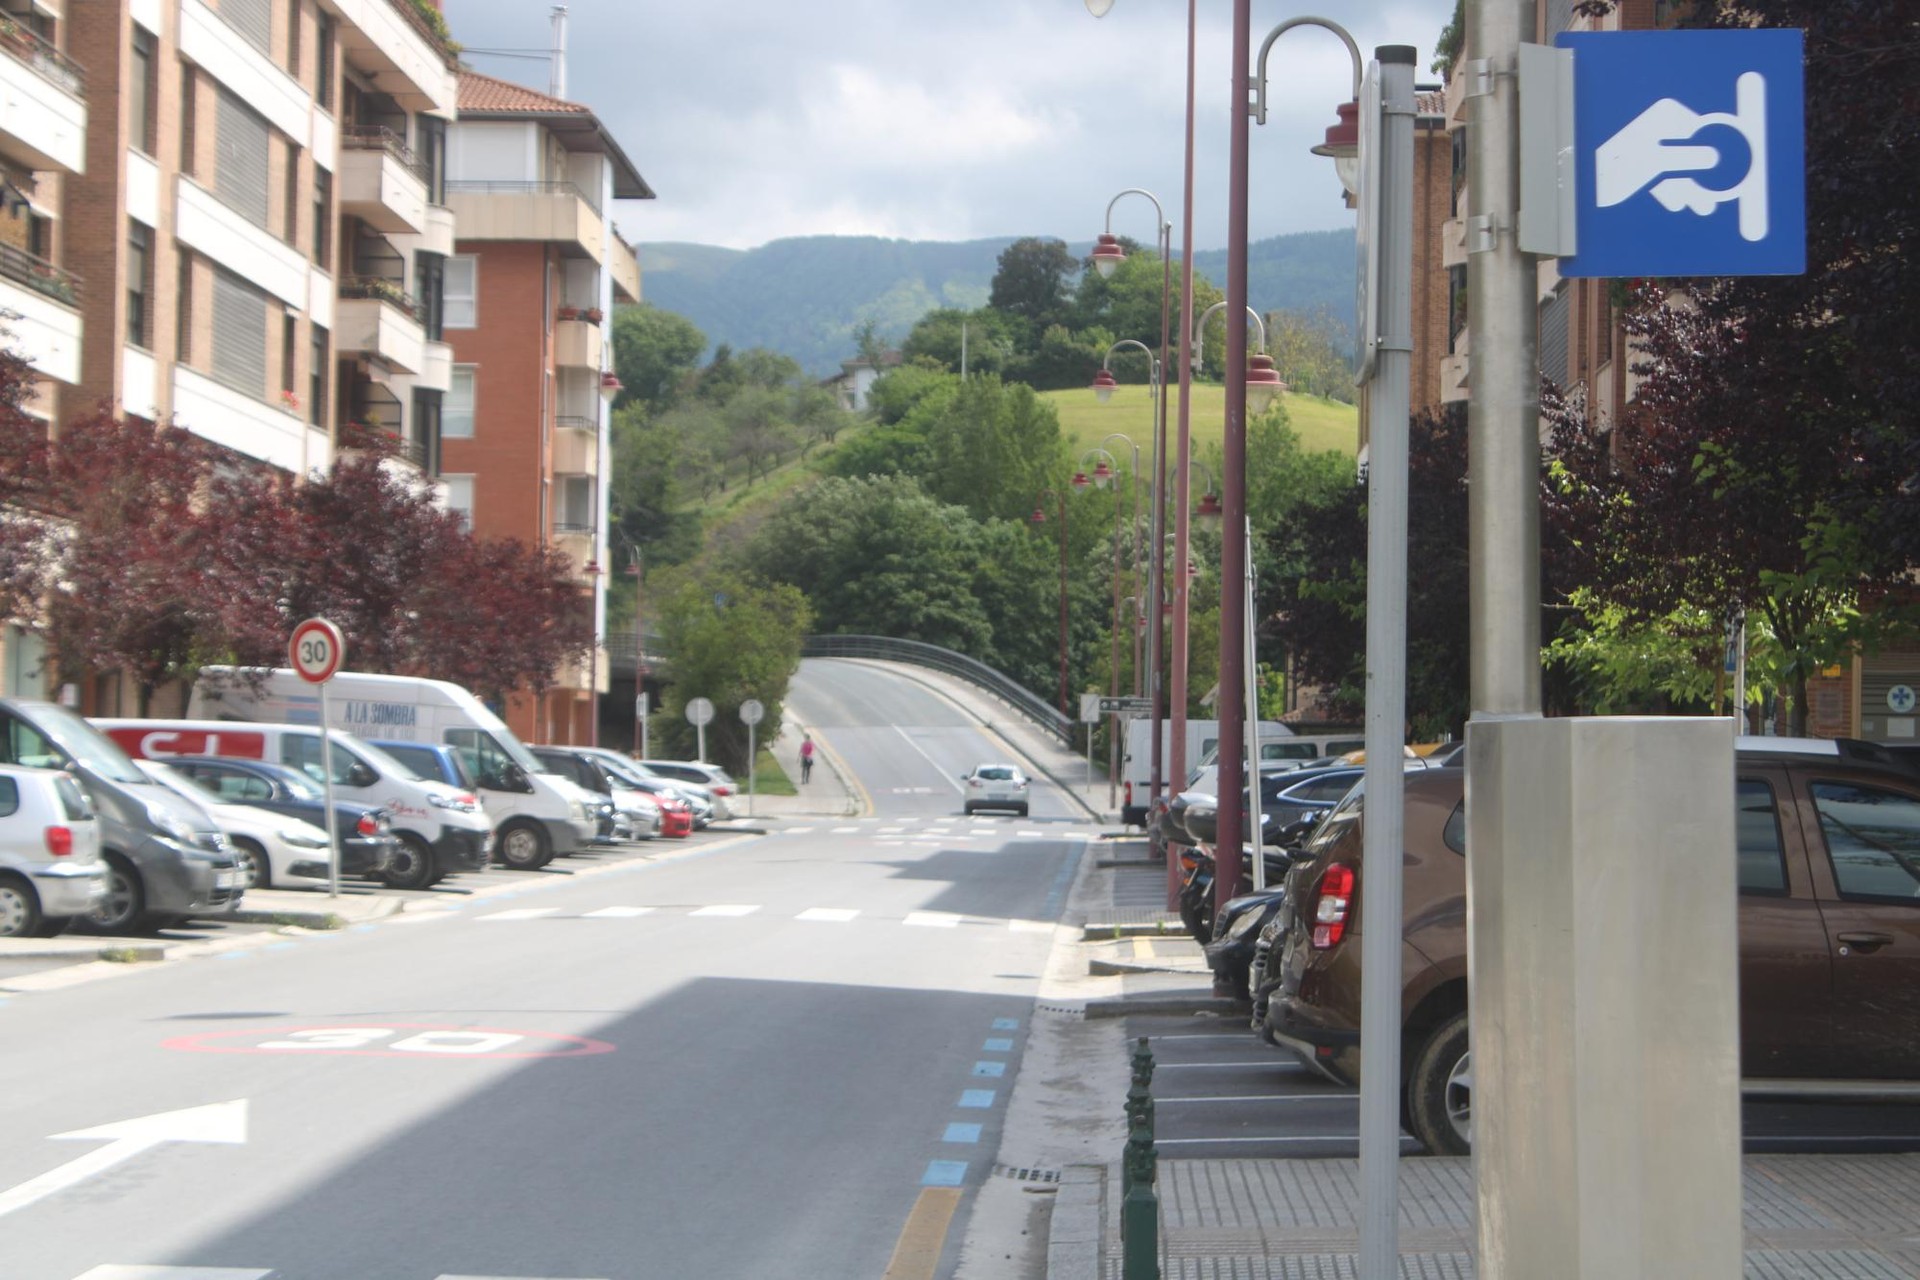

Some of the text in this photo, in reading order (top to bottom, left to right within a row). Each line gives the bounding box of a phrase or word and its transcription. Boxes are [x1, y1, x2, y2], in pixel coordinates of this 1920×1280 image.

[301, 640, 327, 664] 30
[344, 702, 416, 726] A LA SOMBRA
[256, 1030, 524, 1053] 30
